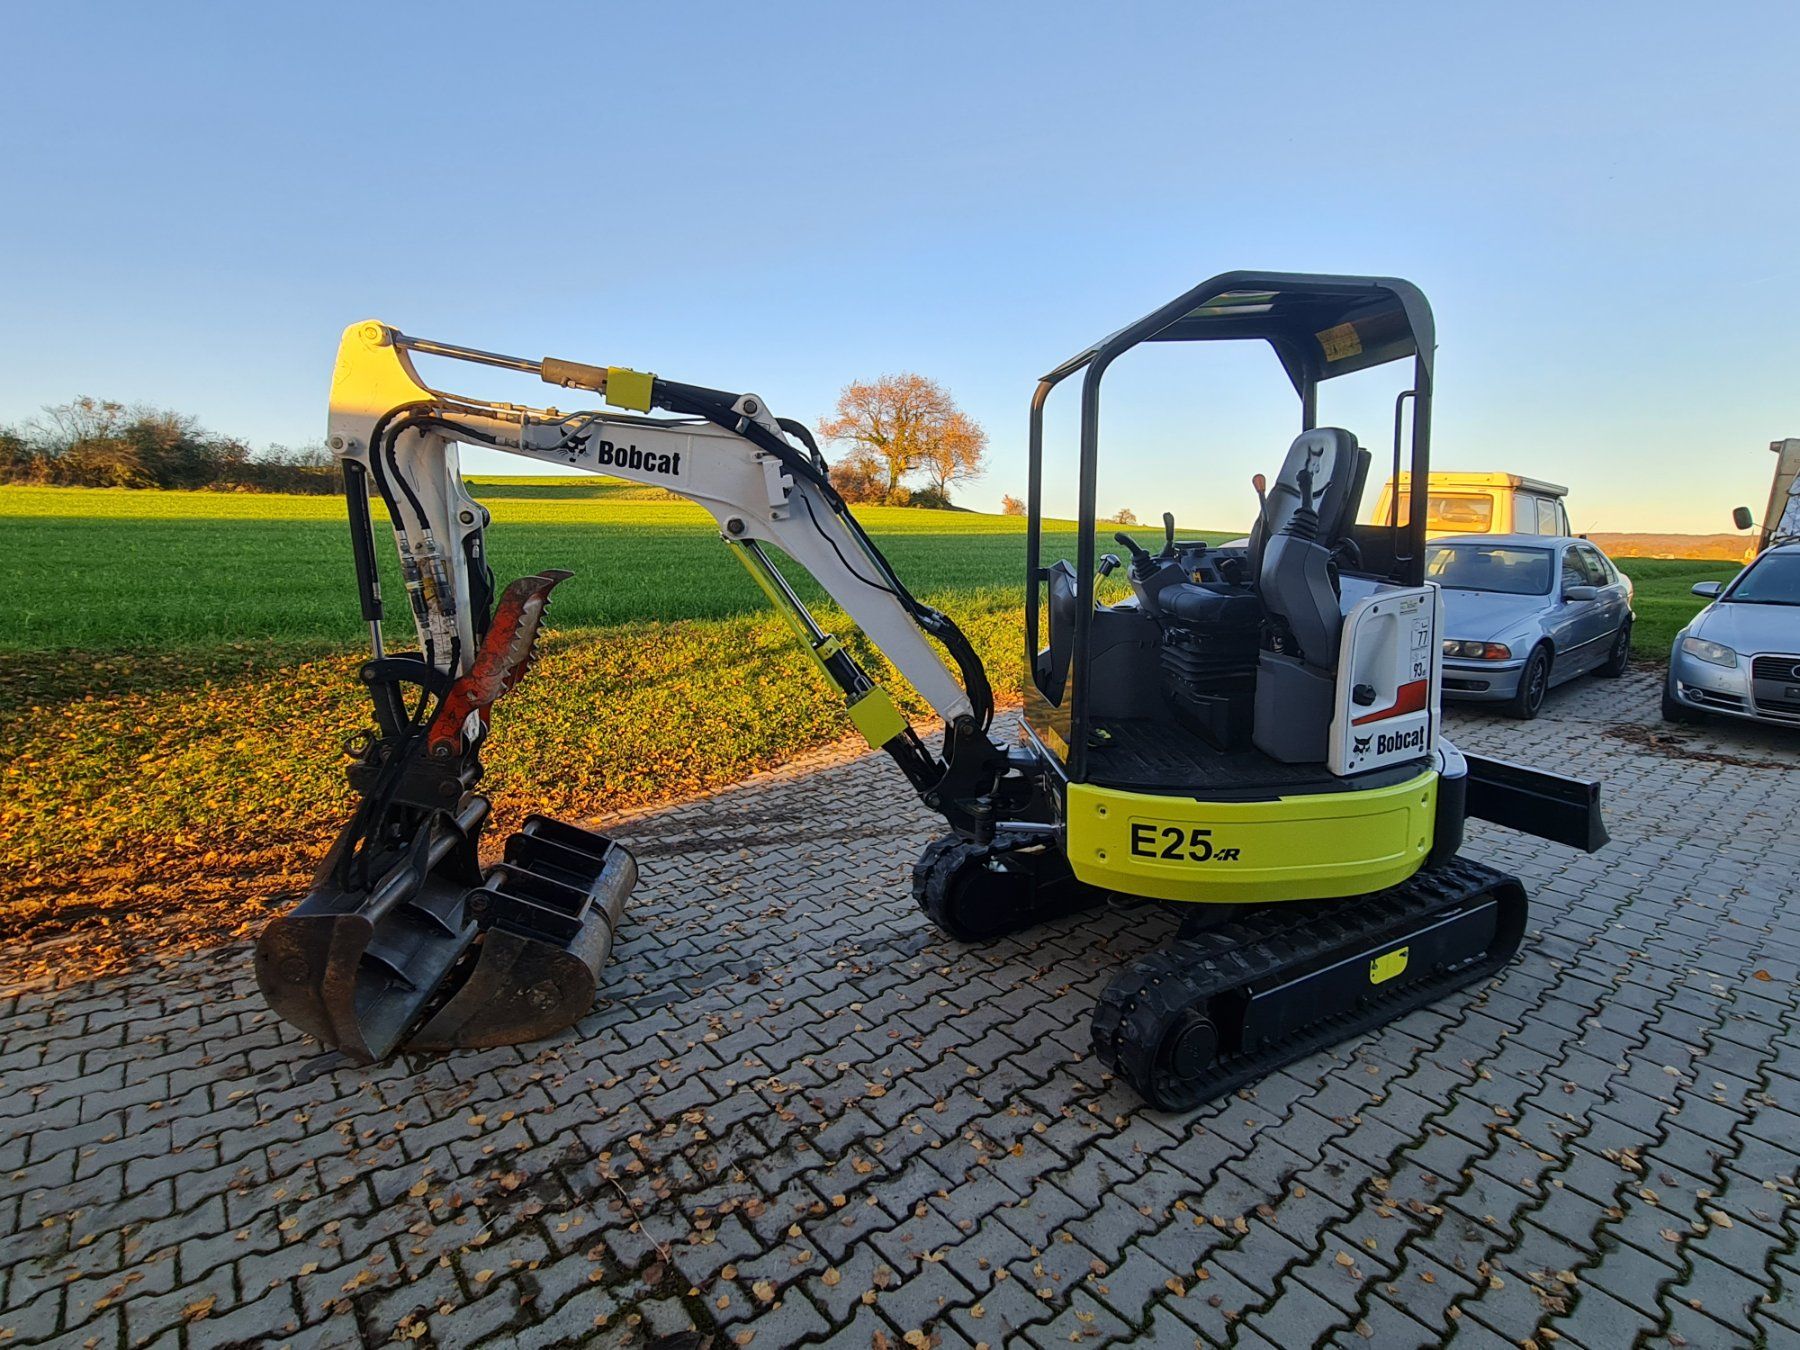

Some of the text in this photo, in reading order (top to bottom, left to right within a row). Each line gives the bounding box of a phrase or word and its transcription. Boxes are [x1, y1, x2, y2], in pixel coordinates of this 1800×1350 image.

[598, 440, 681, 476] Bobcat
[1417, 630, 1428, 646] 77
[1413, 662, 1423, 678] 93
[1376, 725, 1424, 755] Bobcat
[1131, 823, 1213, 862] E25
